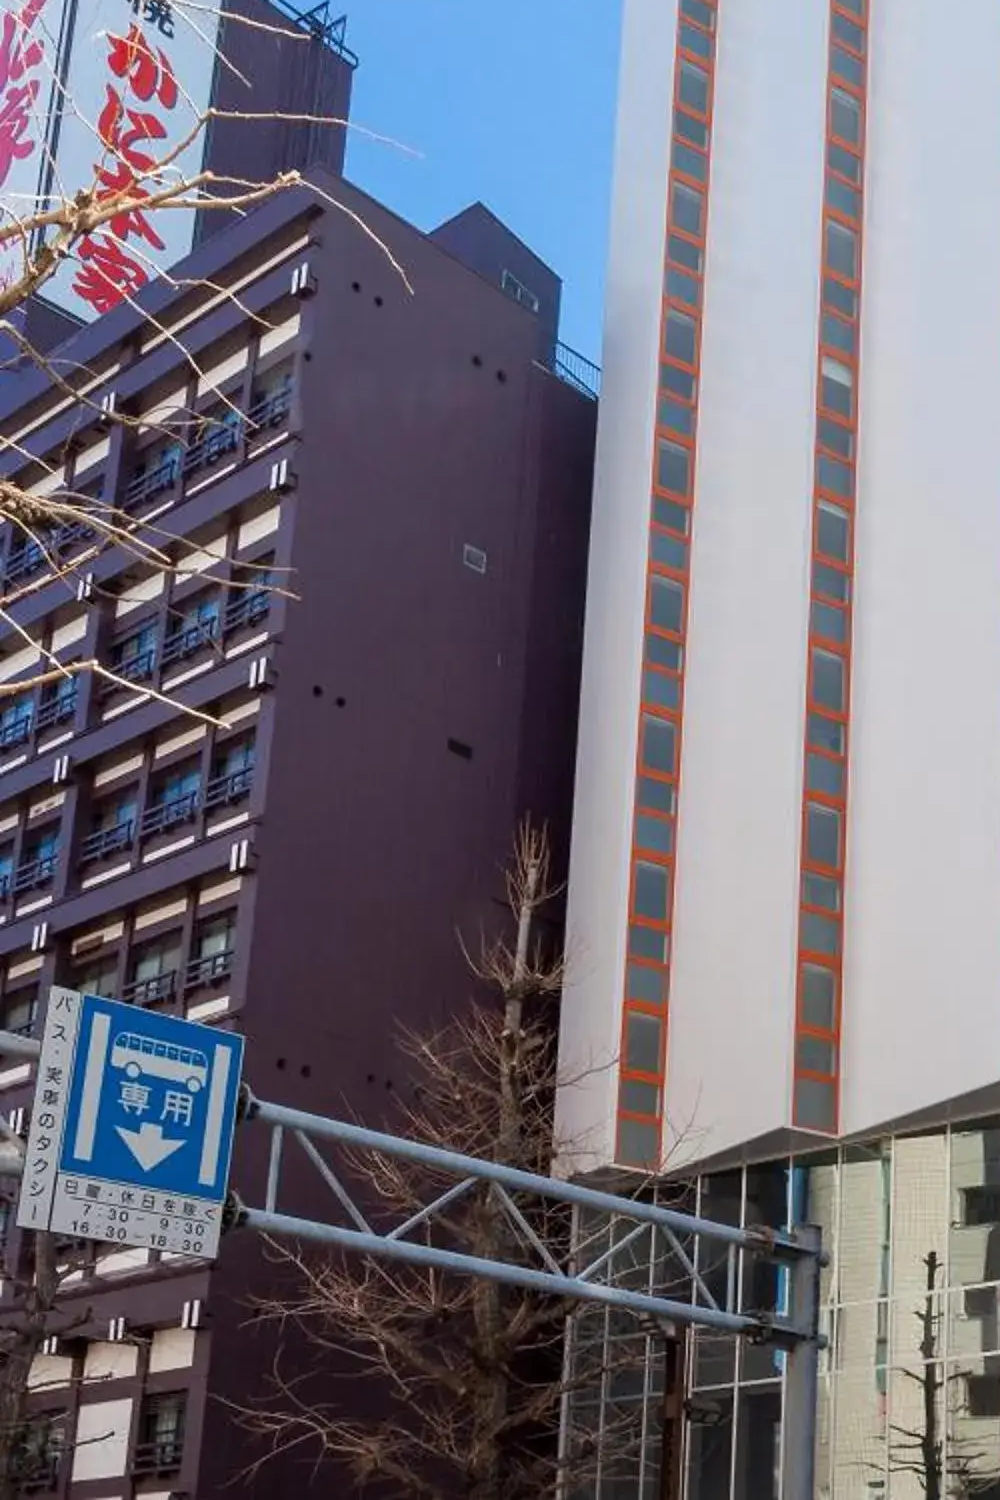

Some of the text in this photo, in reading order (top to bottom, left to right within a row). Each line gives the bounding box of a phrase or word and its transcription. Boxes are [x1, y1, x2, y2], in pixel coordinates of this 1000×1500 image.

[72, 22, 179, 313] かに本家
[117, 1081, 193, 1127] 専用
